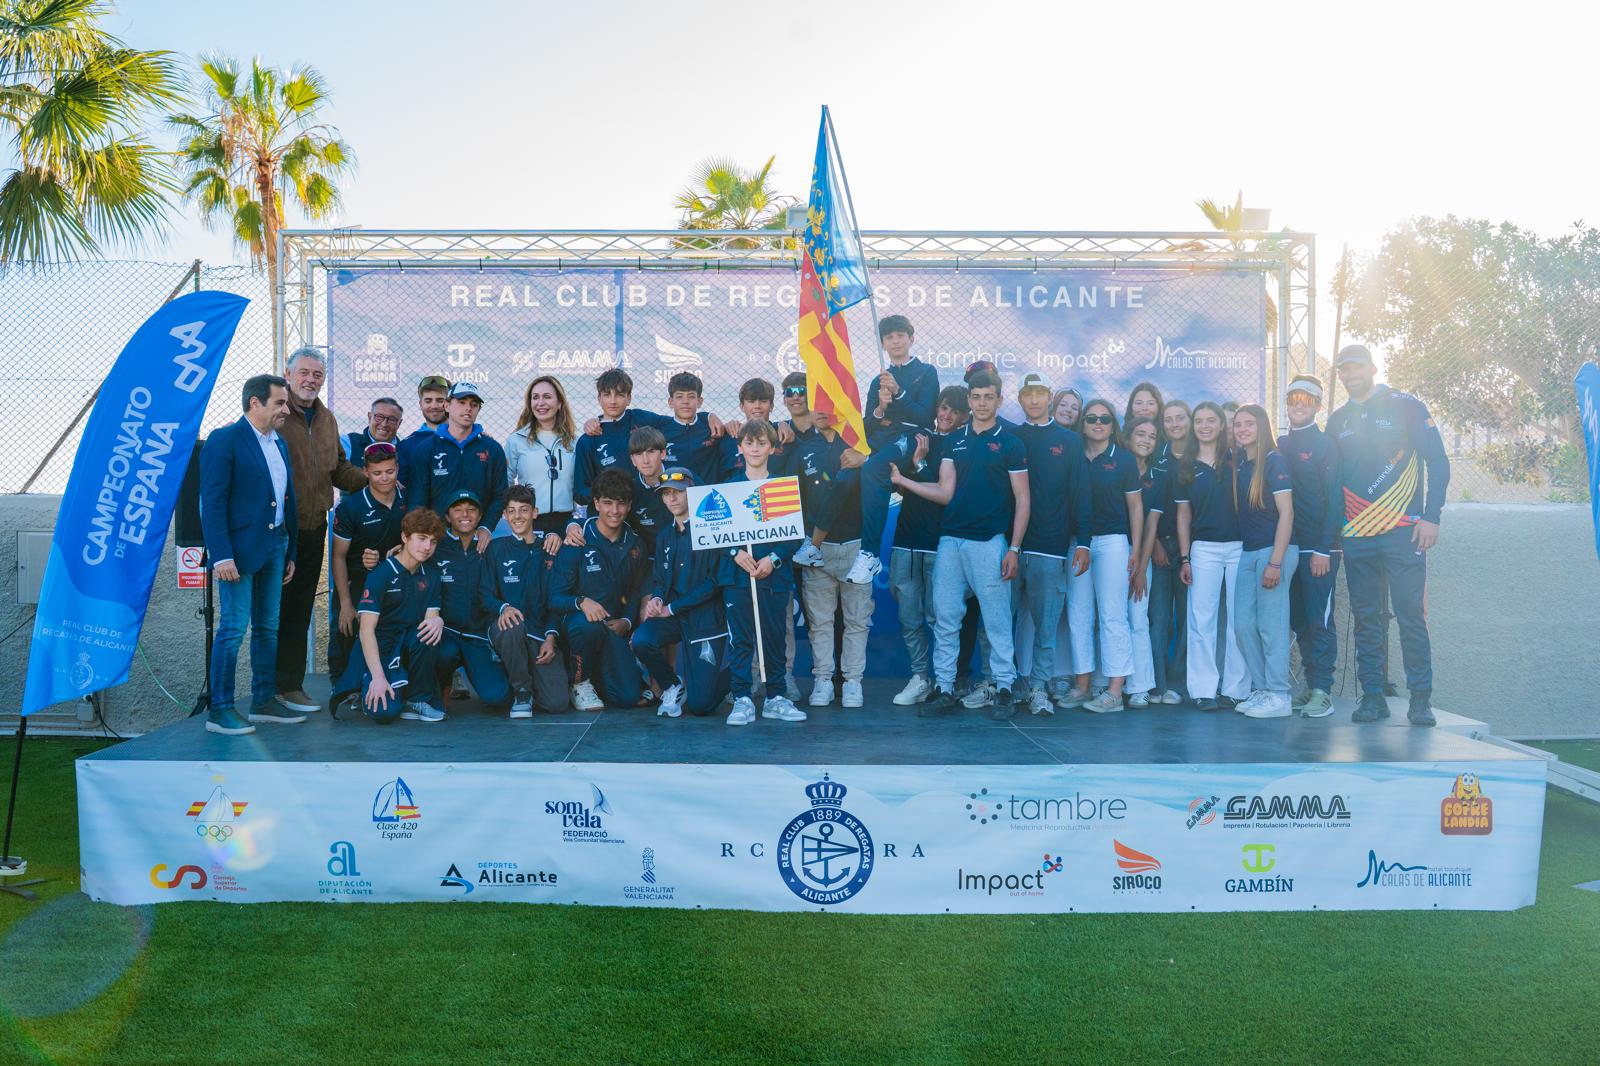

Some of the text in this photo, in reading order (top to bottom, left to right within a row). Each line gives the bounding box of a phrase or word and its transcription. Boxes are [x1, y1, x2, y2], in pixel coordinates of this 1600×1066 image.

[450, 284, 1144, 308] REAL CLUB DE REGS DE ALICANTE
[170, 321, 207, 393] 420
[539, 350, 633, 368] GAMMA
[1037, 349, 1110, 372] Impact
[1167, 357, 1247, 369] CALAS DE ALICANTE
[83, 386, 152, 566] CAMPEONATO
[114, 422, 180, 559] DE ESPAÑA
[698, 525, 799, 546] C. VALENCIANA
[83, 624, 108, 636] CLUB
[109, 629, 123, 639] DE
[80, 635, 92, 644] DE
[545, 800, 583, 815] som
[1008, 792, 1127, 820] tambre
[1223, 795, 1351, 820] GAMMA
[1444, 802, 1488, 817] GOFRE
[562, 808, 602, 829] vela
[1223, 822, 1251, 830] Imprenta
[1444, 817, 1489, 829] LANDIA
[376, 822, 418, 831] Clase 420
[562, 829, 608, 838] FEDERACIÓ
[1044, 824, 1091, 832] Reproductiva
[382, 831, 412, 840] España
[782, 809, 871, 870] REAL CLUB 1889 DE REGATAS
[721, 843, 926, 858] R C R A
[318, 879, 372, 888] DIPUTACIÓN
[478, 869, 558, 884] Alicante
[958, 868, 1044, 895] Impact
[1112, 874, 1162, 890] SIROCO
[1225, 875, 1295, 893] GAMBÍN
[1382, 873, 1472, 887] CALAS DE ALICANTE
[333, 887, 373, 895] ALICANTE
[624, 886, 675, 894] GENERALITAT
[801, 887, 852, 902] ALICANTE
